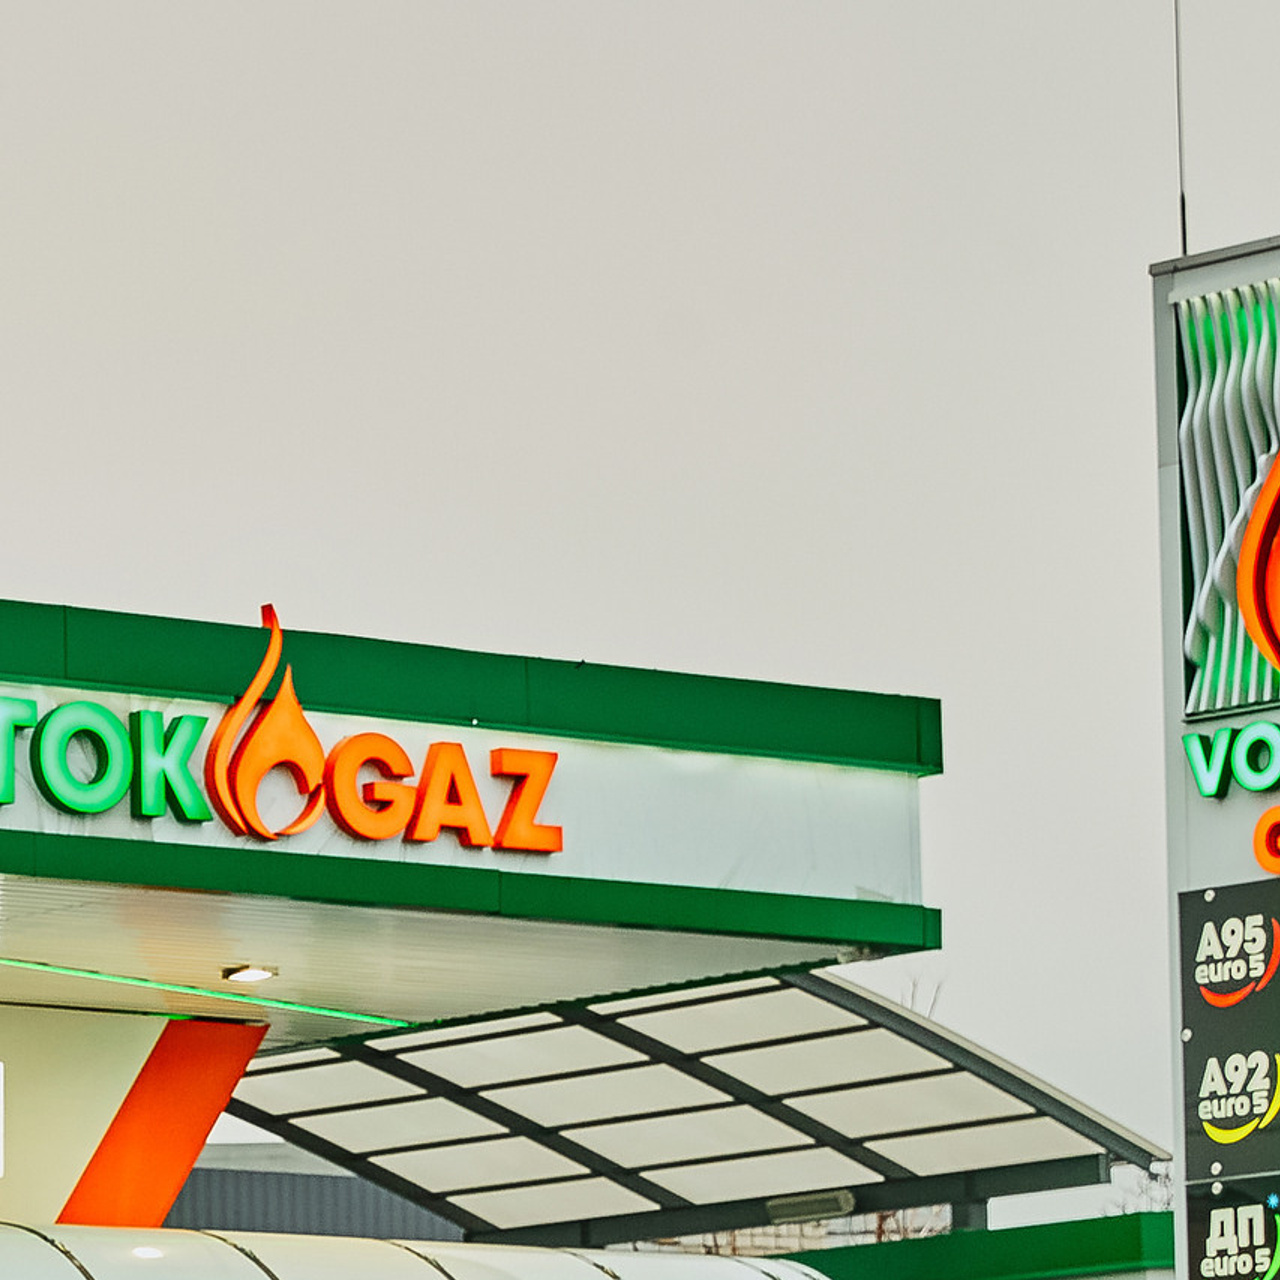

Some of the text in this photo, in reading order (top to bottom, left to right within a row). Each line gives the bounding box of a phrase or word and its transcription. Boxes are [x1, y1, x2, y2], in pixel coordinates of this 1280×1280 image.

[324, 731, 563, 853] GAZ
[1195, 914, 1267, 963] A95
[1199, 1050, 1271, 1098] A92
[1206, 1204, 1266, 1257] ДП
